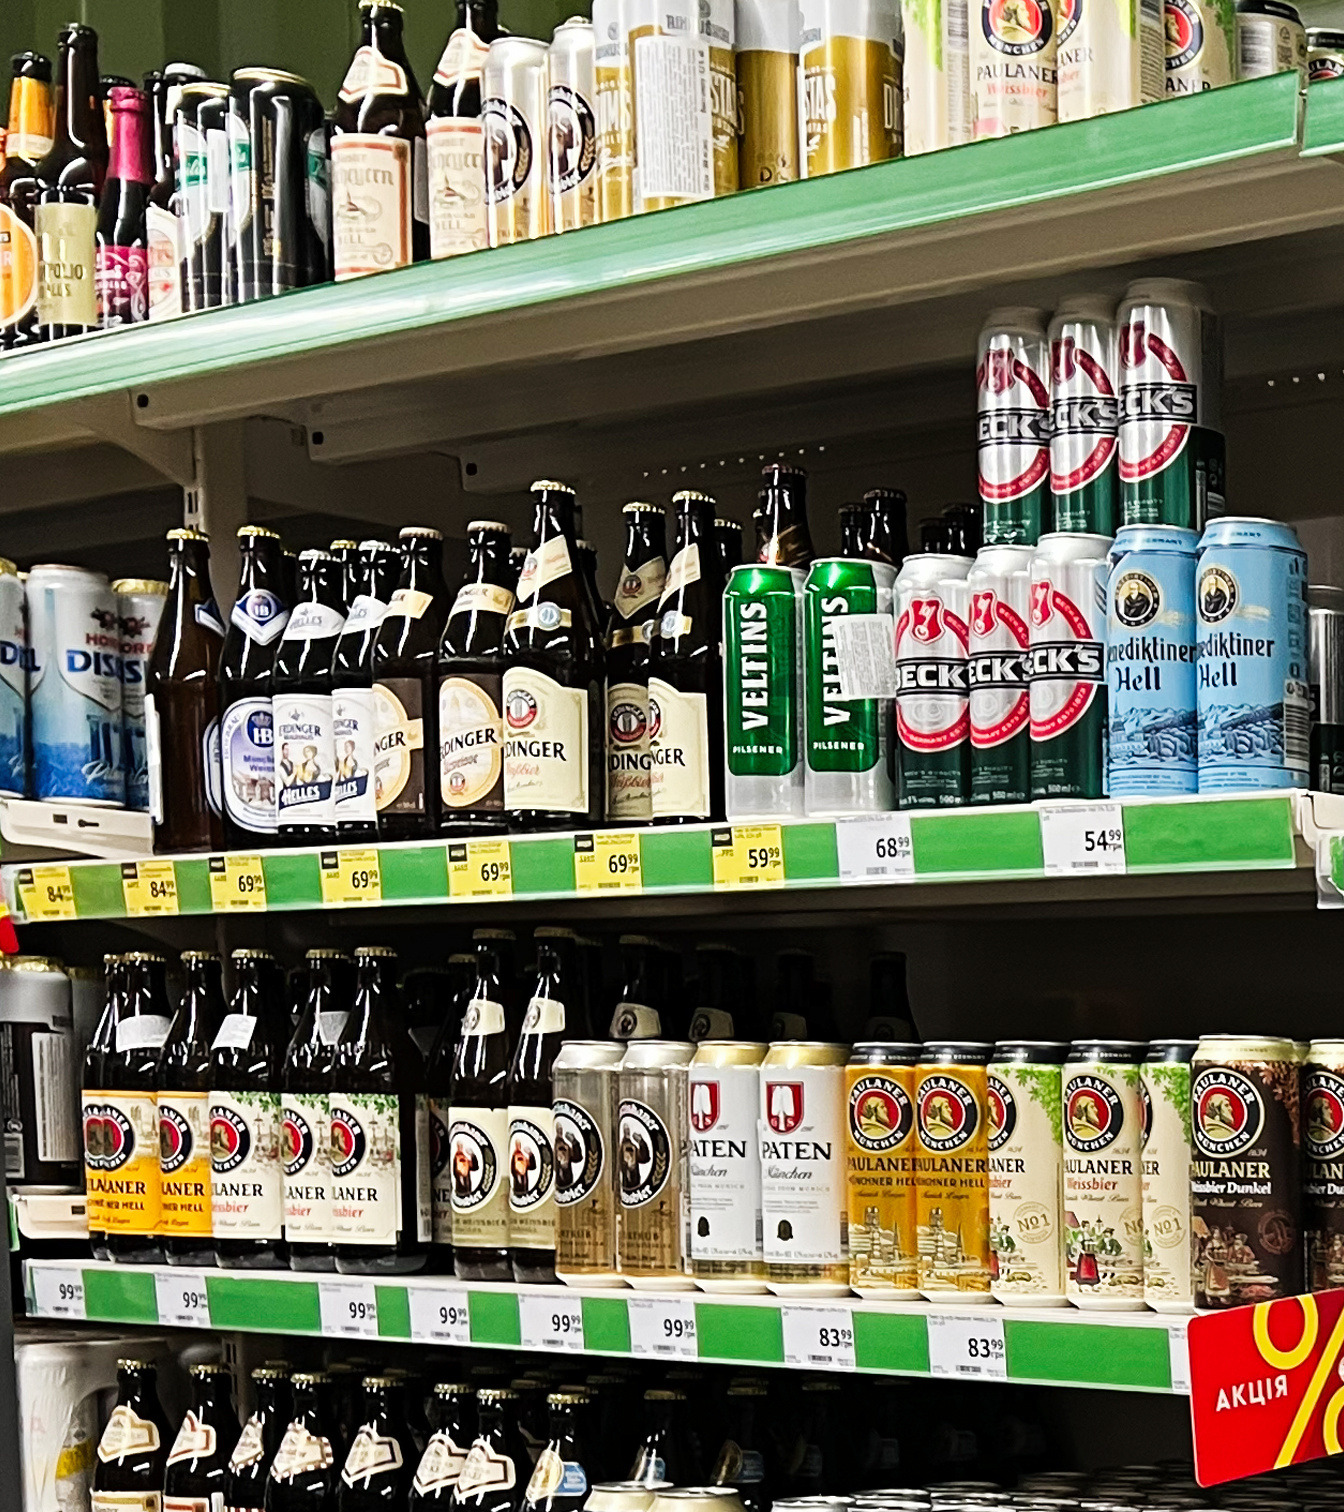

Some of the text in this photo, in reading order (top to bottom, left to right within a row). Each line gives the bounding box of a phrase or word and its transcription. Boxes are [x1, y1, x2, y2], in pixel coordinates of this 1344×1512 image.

[741, 602, 768, 732] VELTINS
[1115, 667, 1162, 693] Hell
[732, 744, 783, 755] PILSENER
[812, 740, 865, 751] PILSENER
[280, 786, 321, 805] HELLES
[876, 838, 897, 859] 68
[1085, 831, 1107, 852] 54
[748, 848, 767, 869] 59
[761, 1139, 833, 1162] PATEN
[819, 1327, 840, 1348] 83
[968, 1337, 989, 1359] 83
[1215, 1376, 1289, 1413] АКЦІЯ
